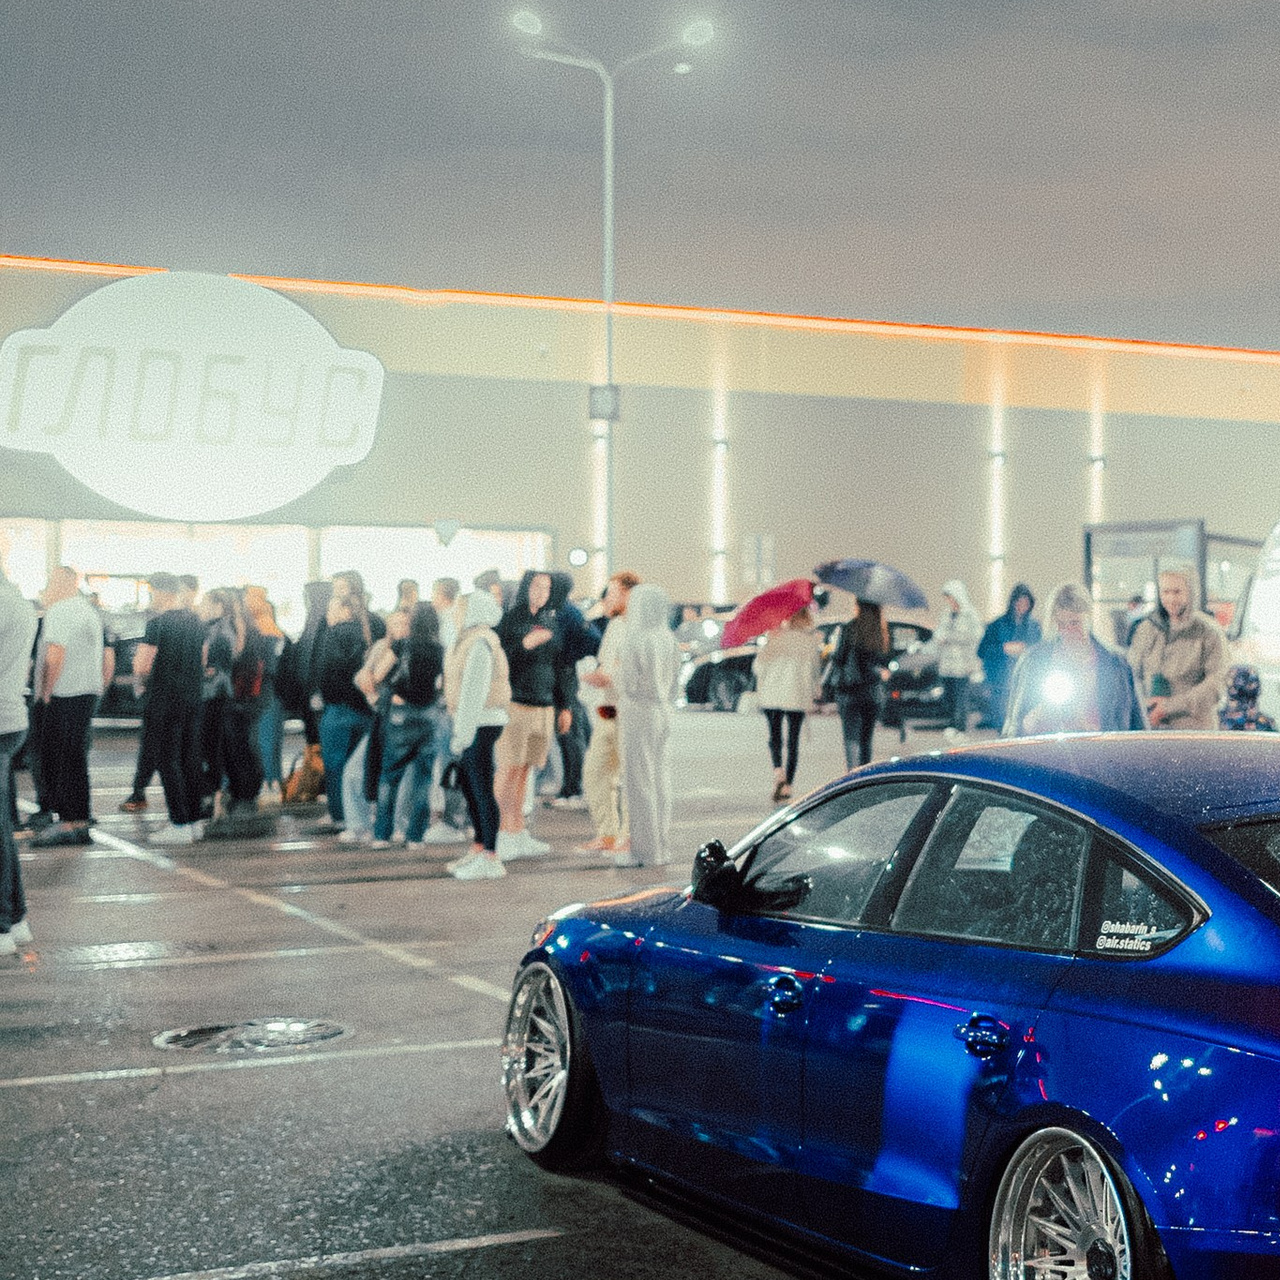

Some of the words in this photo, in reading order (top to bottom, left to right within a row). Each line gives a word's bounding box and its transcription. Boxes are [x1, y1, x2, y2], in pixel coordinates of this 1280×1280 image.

[6, 344, 368, 448] ГЛОБУС
[1101, 920, 1157, 936] @shabarin_s
[1096, 935, 1152, 951] @air.statics
